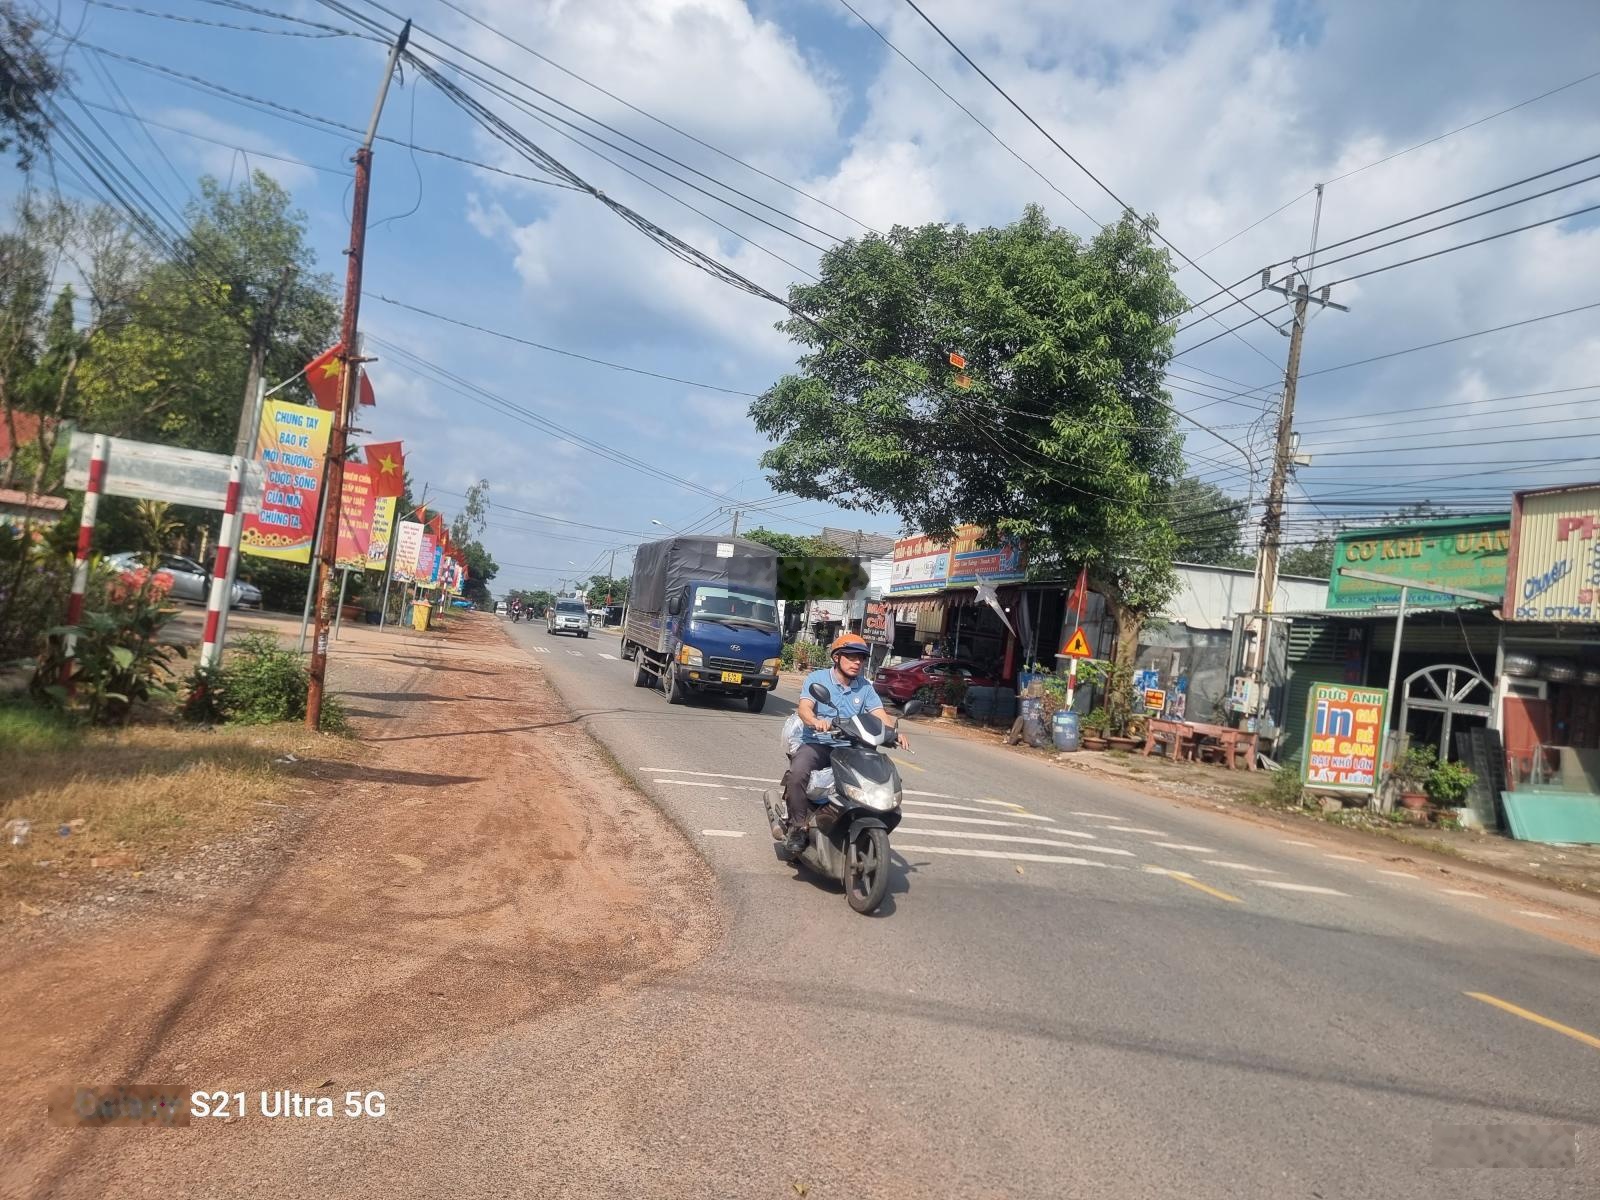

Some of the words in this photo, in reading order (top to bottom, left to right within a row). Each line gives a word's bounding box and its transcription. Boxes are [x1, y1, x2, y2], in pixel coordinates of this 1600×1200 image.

[276, 411, 303, 427] CHUNG
[305, 416, 319, 430] TAY
[293, 473, 316, 490] SỐNG
[259, 509, 288, 527] CHÚNG
[1345, 540, 1377, 562] CƠ
[1380, 533, 1424, 561] KHÍ
[1318, 688, 1348, 701] ĐỨC
[1352, 692, 1382, 705] ANH
[1315, 700, 1353, 737] in
[1339, 742, 1375, 757] CAN
